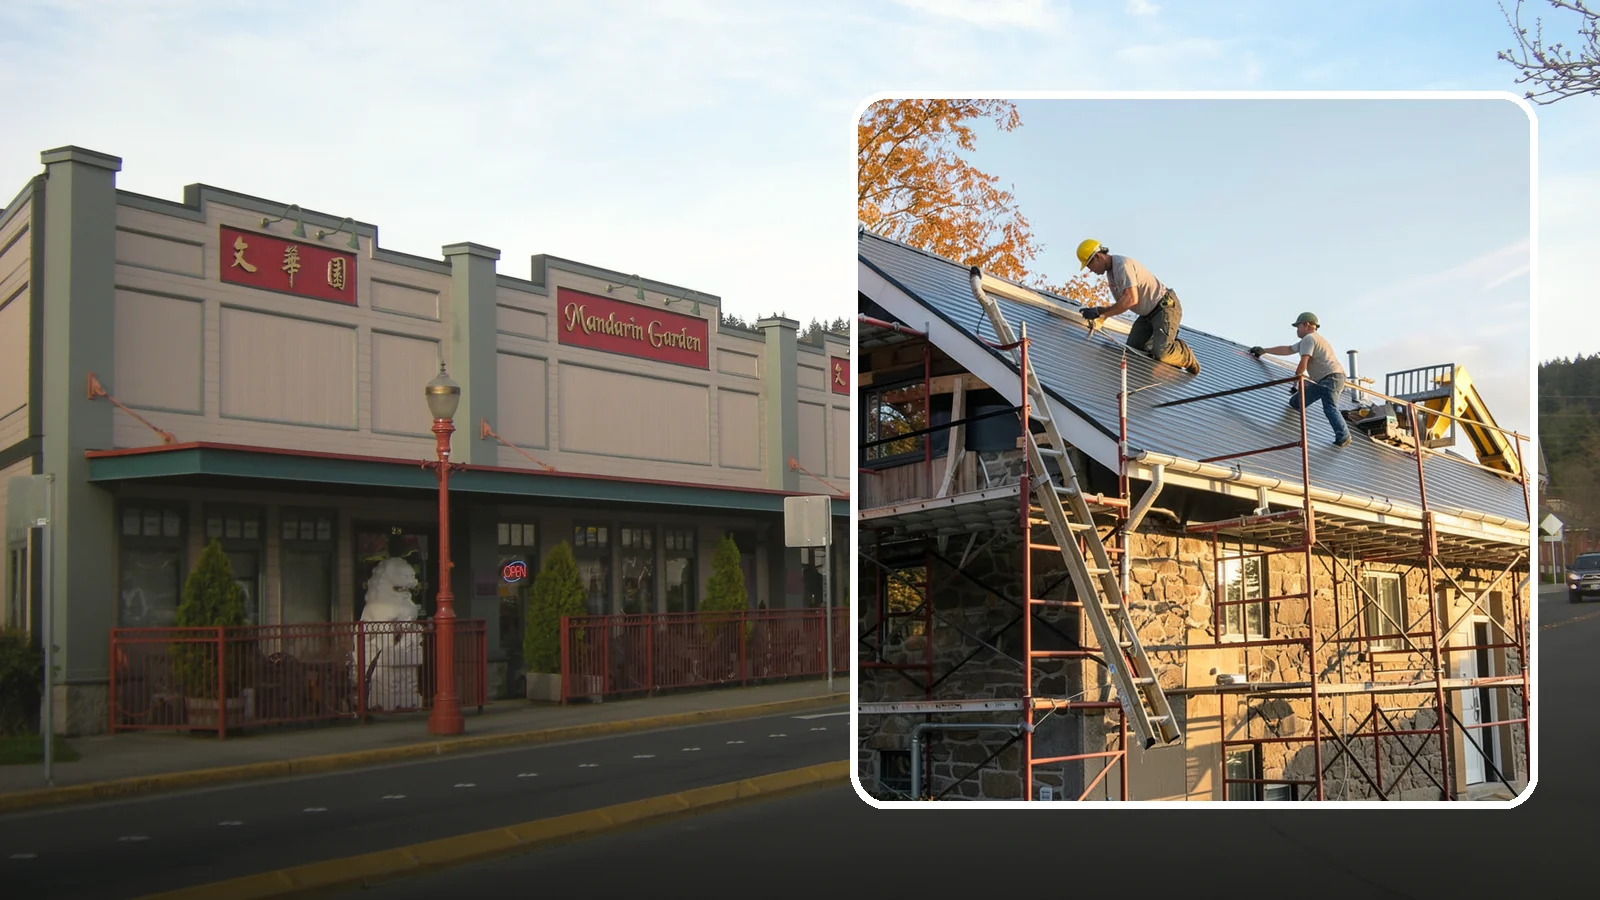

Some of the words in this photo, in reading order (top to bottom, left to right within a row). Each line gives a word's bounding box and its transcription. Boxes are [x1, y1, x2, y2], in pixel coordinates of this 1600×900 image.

[564, 302, 644, 341] Mandarin
[647, 320, 702, 352] Garden
[503, 565, 527, 578] OPEN
